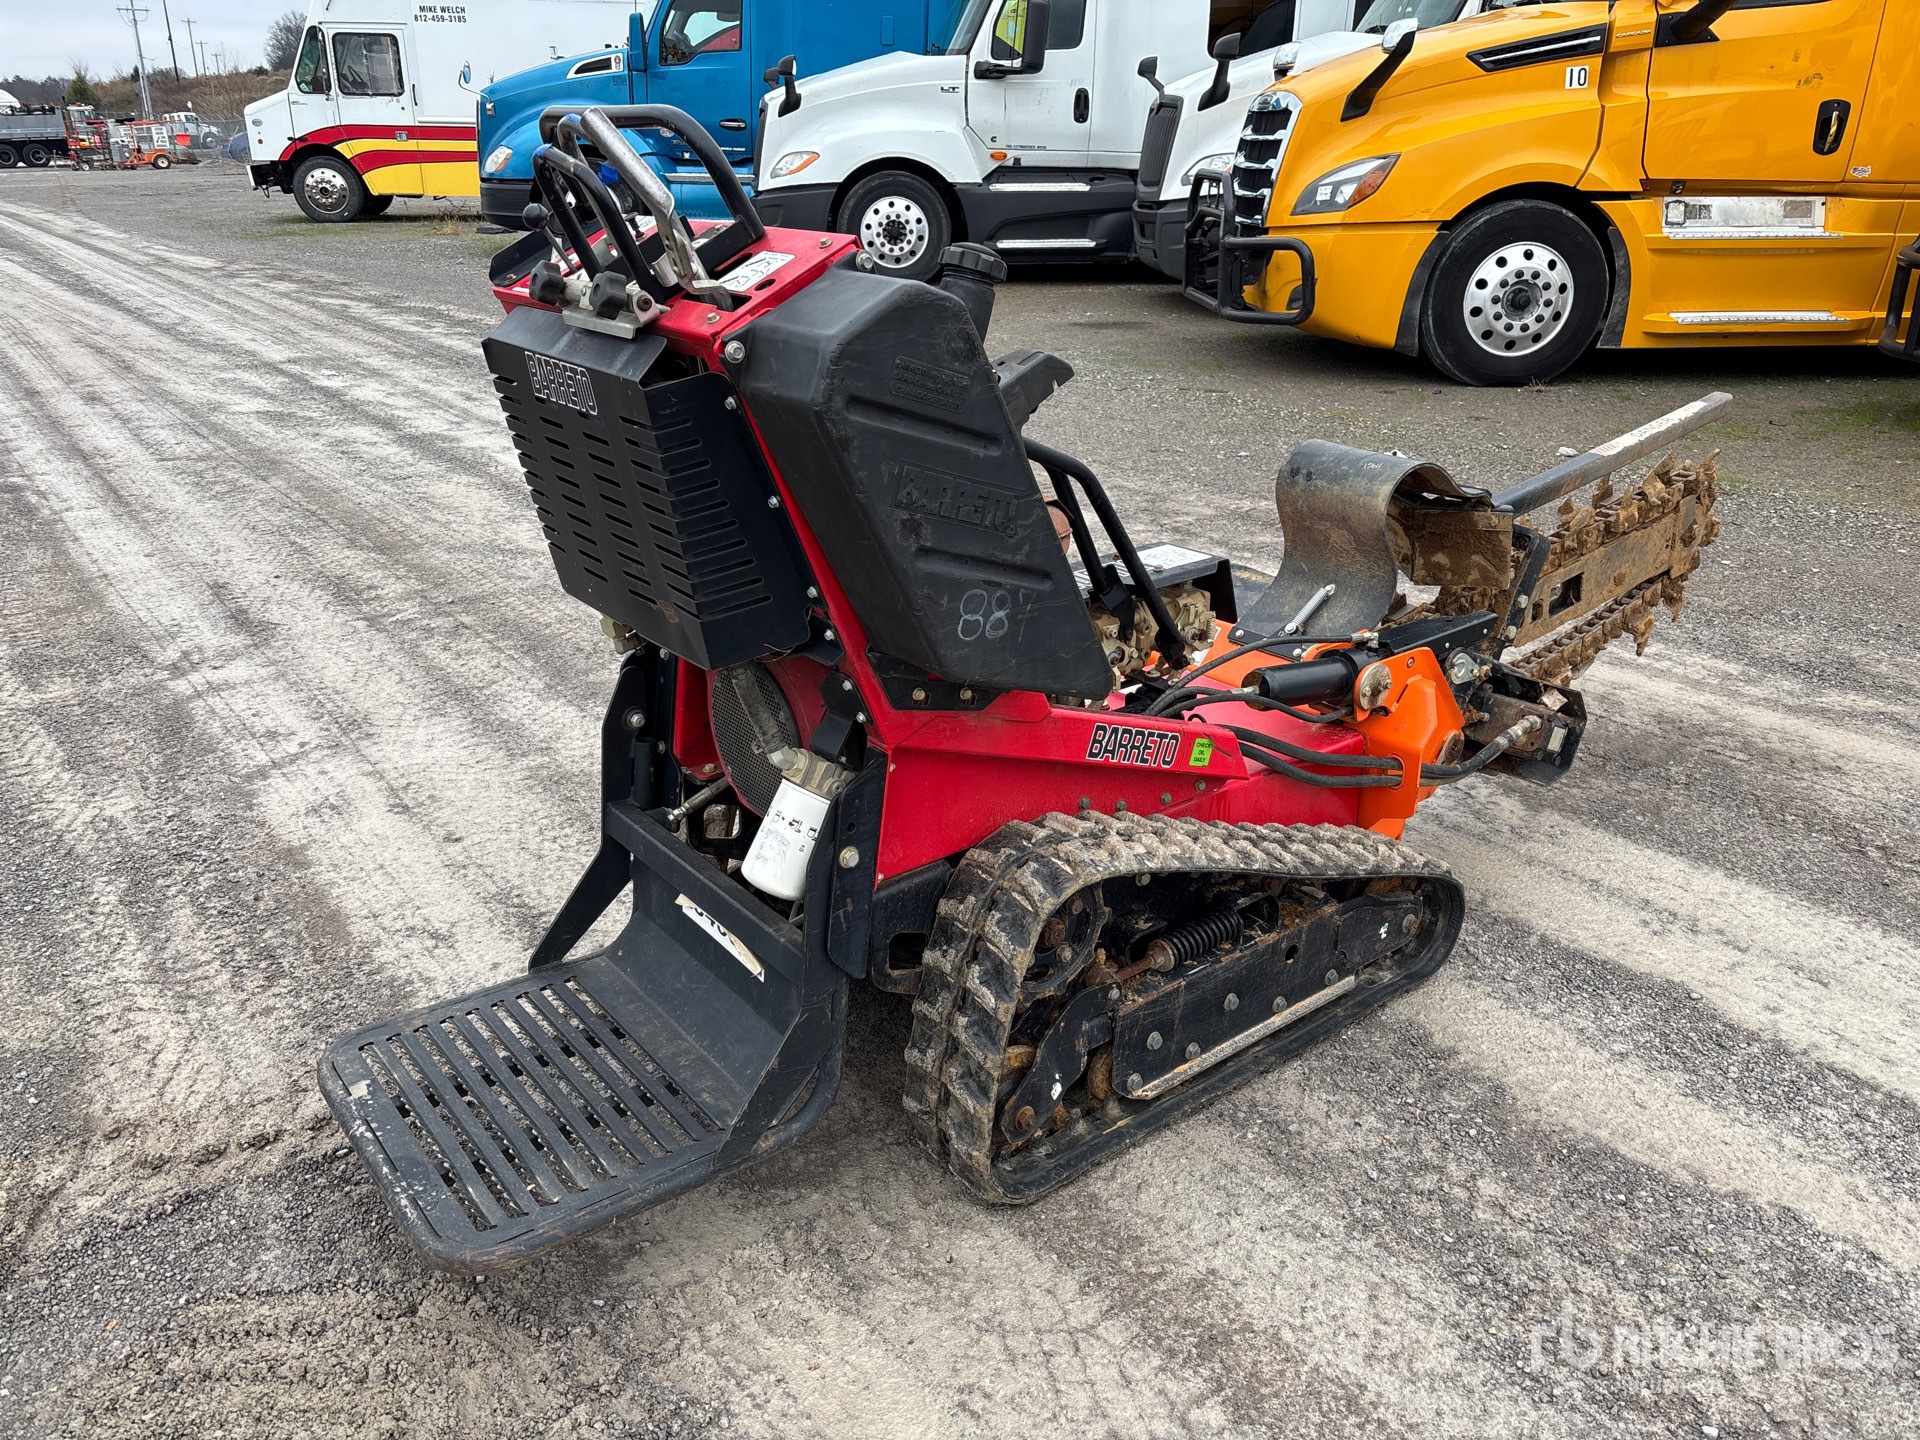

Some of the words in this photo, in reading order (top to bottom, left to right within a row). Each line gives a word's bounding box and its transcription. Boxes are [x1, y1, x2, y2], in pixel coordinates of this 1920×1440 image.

[414, 14, 467, 23] 812-459-3185
[419, 5, 438, 13] MIKE
[440, 5, 466, 14] WELCH
[1568, 67, 1587, 87] 10
[524, 350, 598, 416] BARRETO
[896, 465, 1019, 538] BARRETO
[1086, 722, 1181, 768] BARRETO
